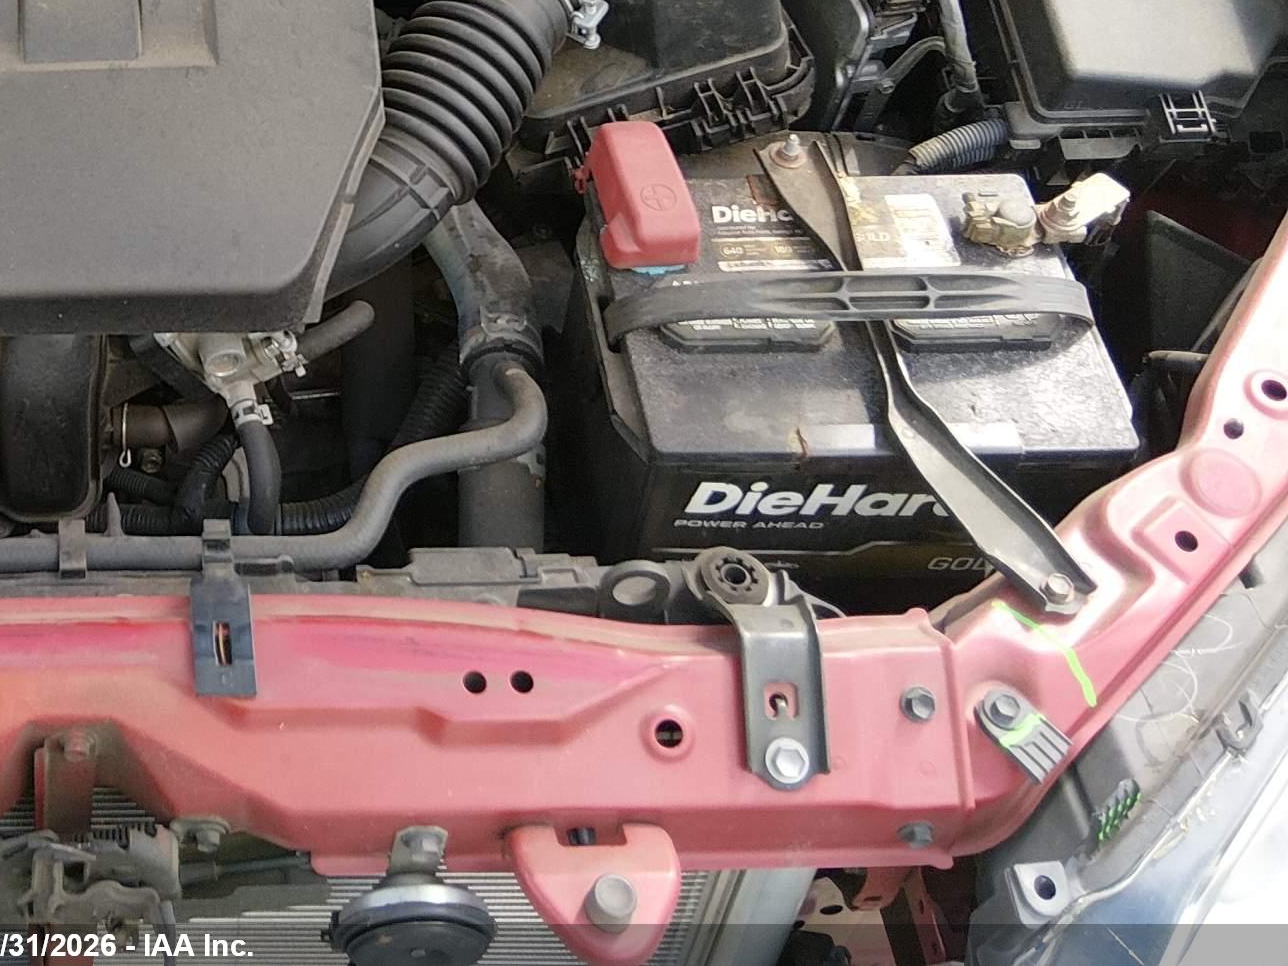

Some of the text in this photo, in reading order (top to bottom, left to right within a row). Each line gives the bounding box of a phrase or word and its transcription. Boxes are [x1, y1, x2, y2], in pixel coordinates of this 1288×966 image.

[673, 519, 824, 530] POWER AHEAD
[927, 556, 987, 571] GOL
